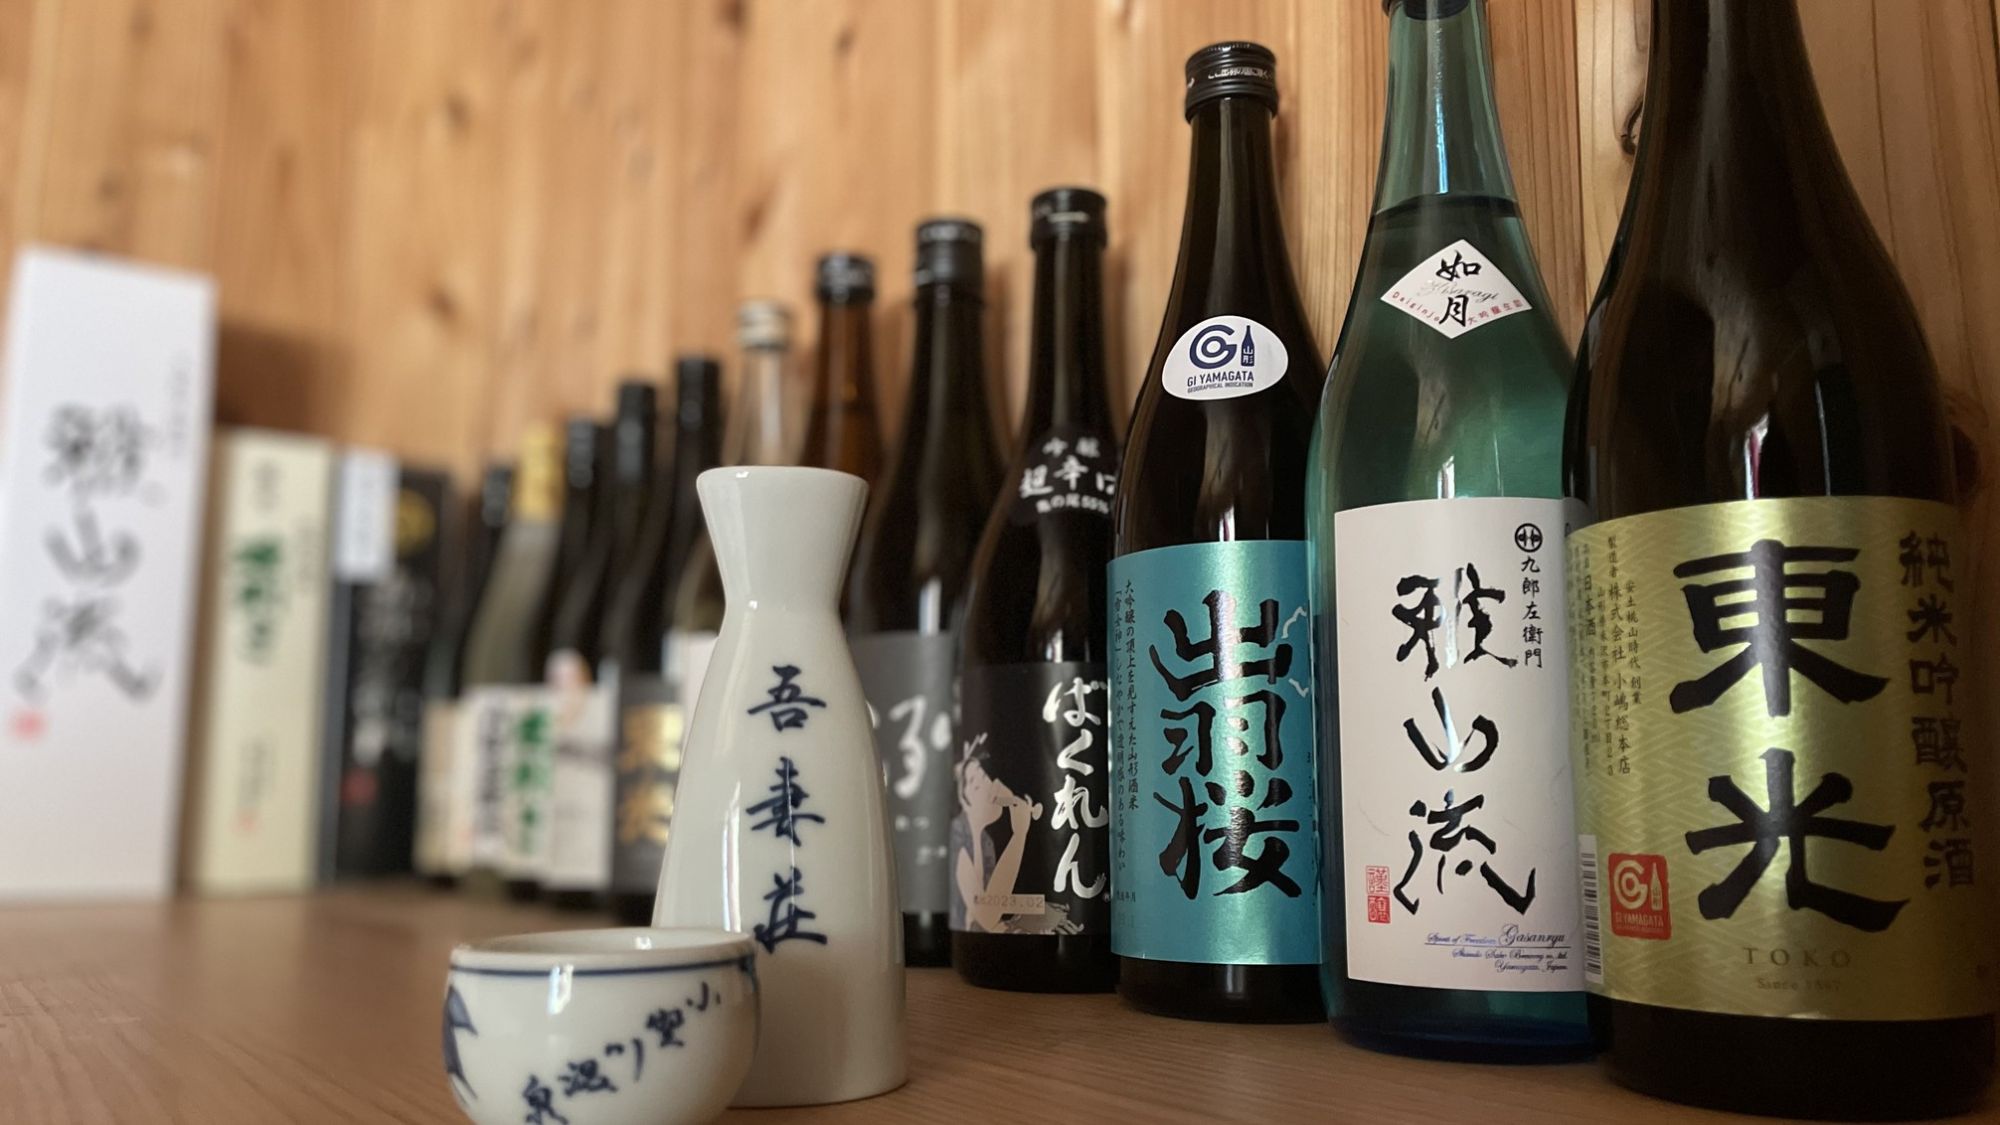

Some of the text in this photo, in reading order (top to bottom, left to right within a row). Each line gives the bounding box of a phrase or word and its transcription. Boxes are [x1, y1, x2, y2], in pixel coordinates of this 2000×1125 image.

[1436, 250, 1482, 327] 如月
[1187, 371, 1254, 387] GI YAMAGATA
[1521, 556, 1544, 669] 九郎左衛門
[1042, 676, 1110, 899] ばくれん
[1148, 589, 1302, 901] 出羽桜
[1391, 562, 1536, 916] 雅山流
[1670, 539, 1911, 933] 東光
[1498, 923, 1566, 947] Gasanryu
[1743, 947, 1852, 968] TOKO
